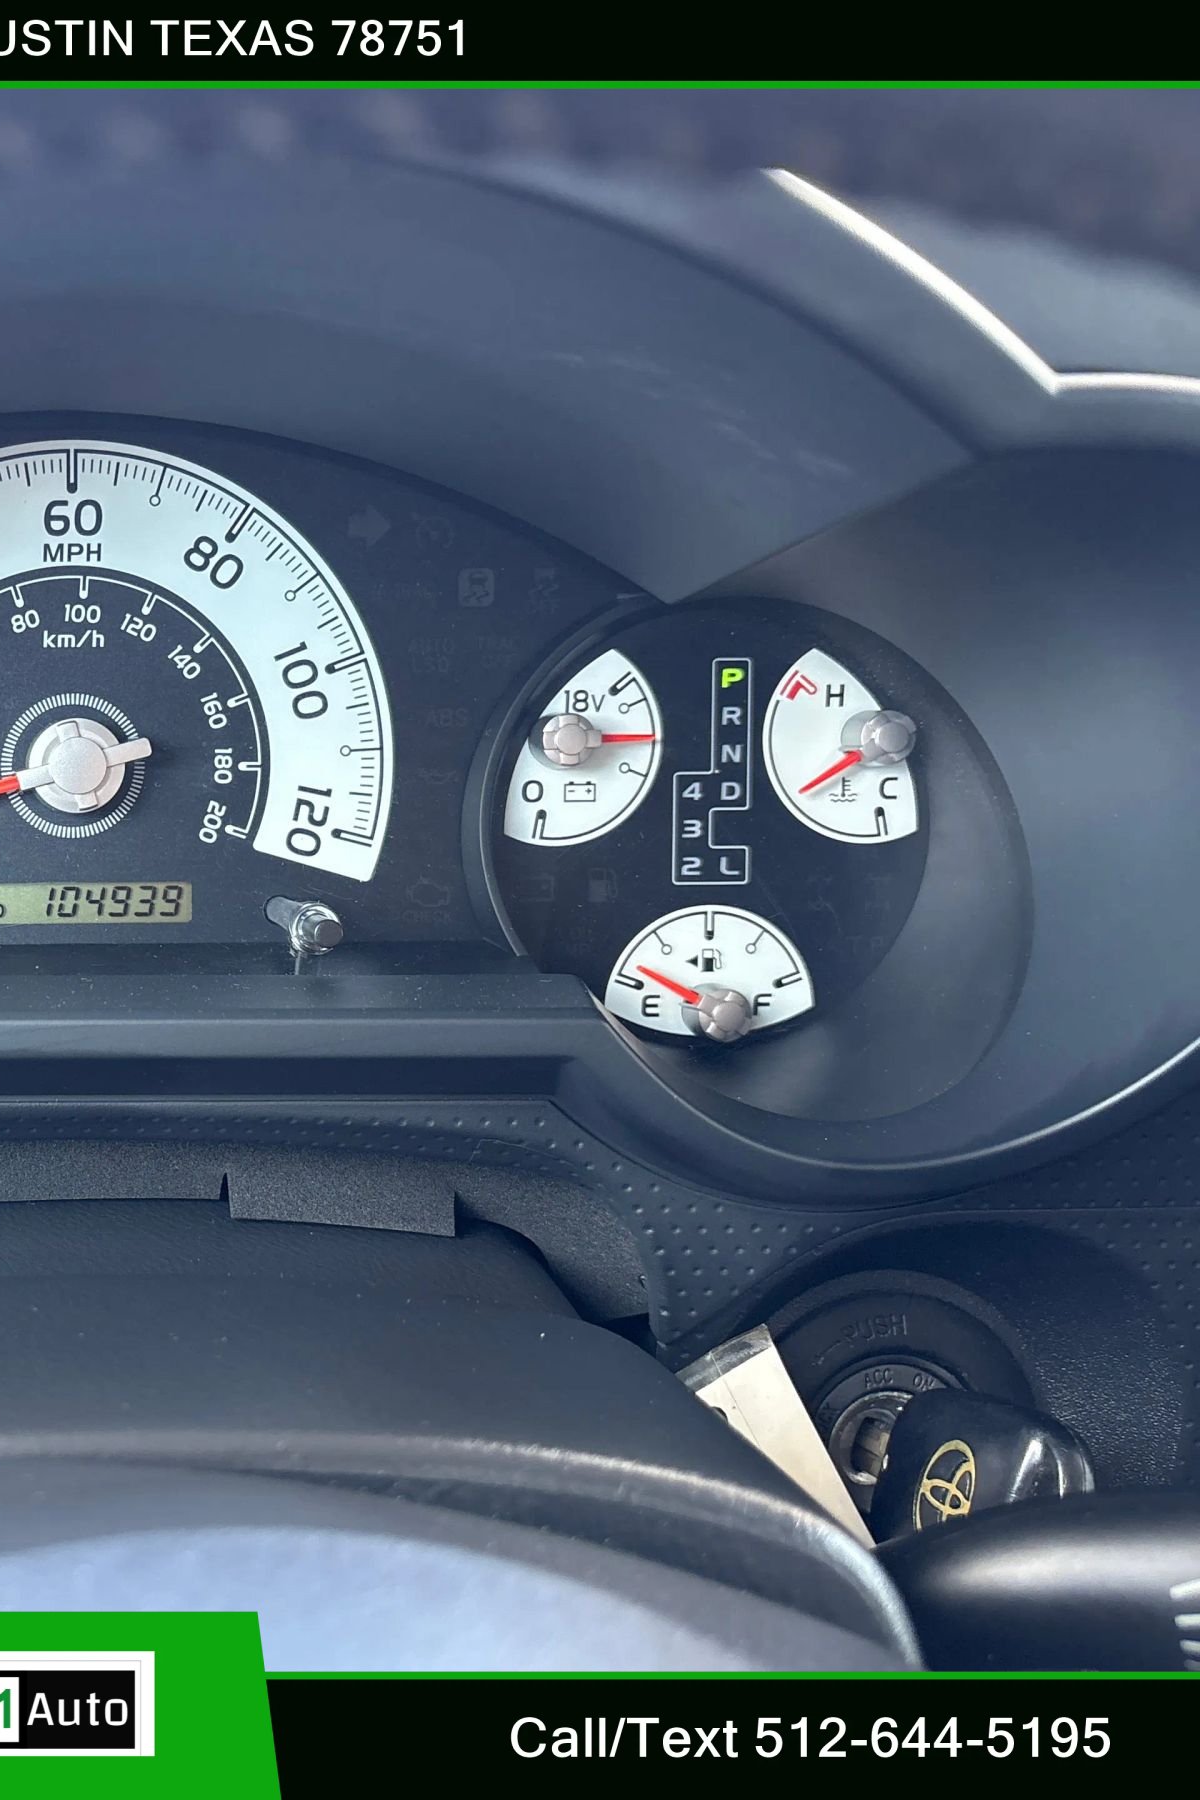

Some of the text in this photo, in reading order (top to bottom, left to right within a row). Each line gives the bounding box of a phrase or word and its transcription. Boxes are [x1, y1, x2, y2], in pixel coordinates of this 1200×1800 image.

[42, 499, 103, 537] 60
[42, 543, 102, 563] MPH
[182, 535, 245, 589] 80
[9, 608, 41, 634] 80
[63, 603, 102, 625] 100
[119, 612, 158, 642] 120
[42, 629, 105, 649] km/h
[166, 644, 202, 681] 140
[272, 641, 329, 720] 100
[720, 668, 744, 688] P
[564, 690, 606, 713] 18V
[825, 684, 844, 707] H
[198, 691, 228, 731] 160
[721, 707, 742, 726] R
[721, 744, 742, 763] N
[213, 746, 233, 785] 180
[682, 782, 741, 801] 4 D
[879, 777, 898, 800] C
[198, 801, 226, 844] 200
[284, 784, 333, 857] 120
[682, 820, 701, 838] 3
[681, 857, 740, 876] 2 L
[46, 886, 183, 917] 104939
[642, 995, 660, 1017] E
[753, 993, 773, 1015] F
[840, 1313, 908, 1342] PUSH
[864, 1368, 894, 1388] ACC
